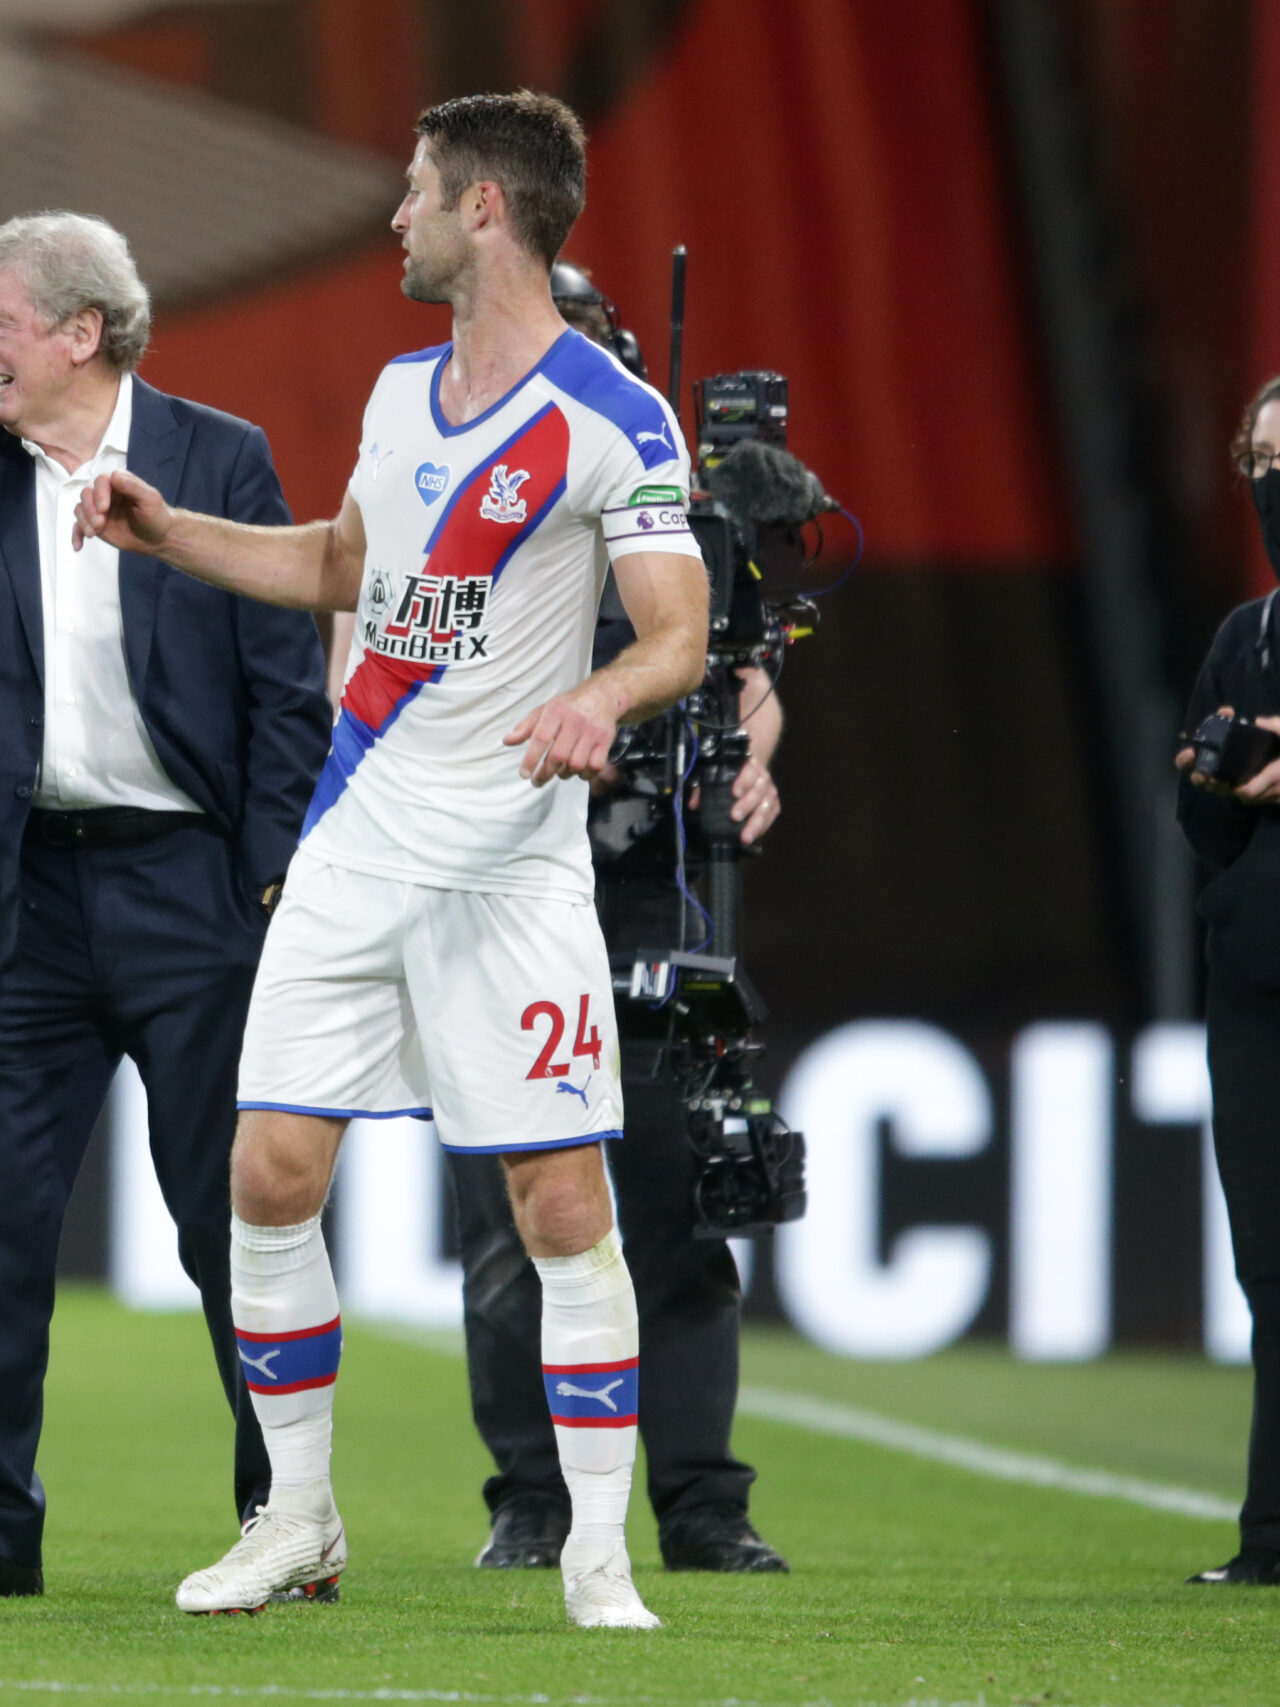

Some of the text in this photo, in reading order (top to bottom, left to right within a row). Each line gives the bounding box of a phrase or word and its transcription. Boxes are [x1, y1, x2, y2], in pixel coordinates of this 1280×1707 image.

[420, 474, 445, 490] NHS
[395, 575, 488, 629] 万博
[364, 620, 489, 662] ManBetX
[521, 993, 602, 1080] 24
